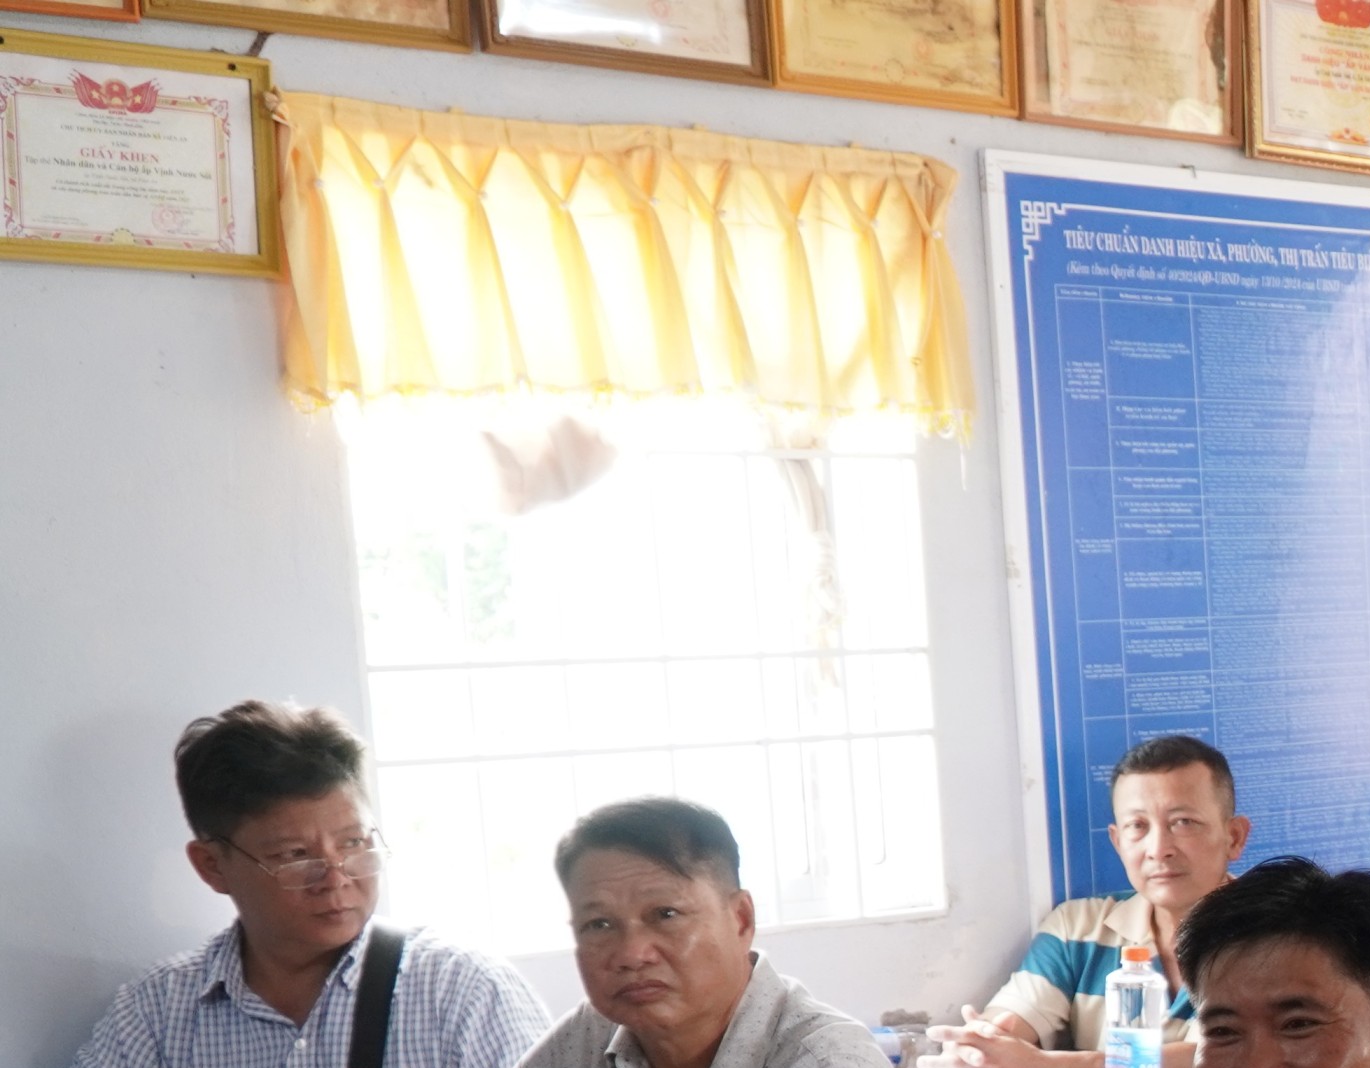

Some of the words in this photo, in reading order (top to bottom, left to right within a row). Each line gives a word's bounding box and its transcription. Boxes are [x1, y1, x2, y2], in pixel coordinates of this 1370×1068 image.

[81, 145, 115, 160] GIẤY
[119, 148, 159, 164] KHEN
[53, 157, 75, 168] Nhân
[78, 159, 93, 169] dân
[97, 160, 106, 170] và
[109, 162, 125, 171] Cán
[129, 164, 139, 175] bộ
[142, 164, 151, 176] ấp
[1064, 227, 1095, 250] TIÊU
[1096, 223, 1139, 255] CHUẨN
[1141, 236, 1175, 259] DANH
[1177, 235, 1206, 263] HIỆU
[1208, 240, 1226, 264] XÃ,
[1228, 241, 1277, 268] PHƯỜNG,
[1279, 247, 1299, 271] THỊ
[1300, 243, 1328, 269] TRẤN
[1330, 247, 1357, 270] TIÊU
[1091, 262, 1109, 275] theo
[1110, 262, 1135, 279] Quyết
[1136, 266, 1155, 281] định
